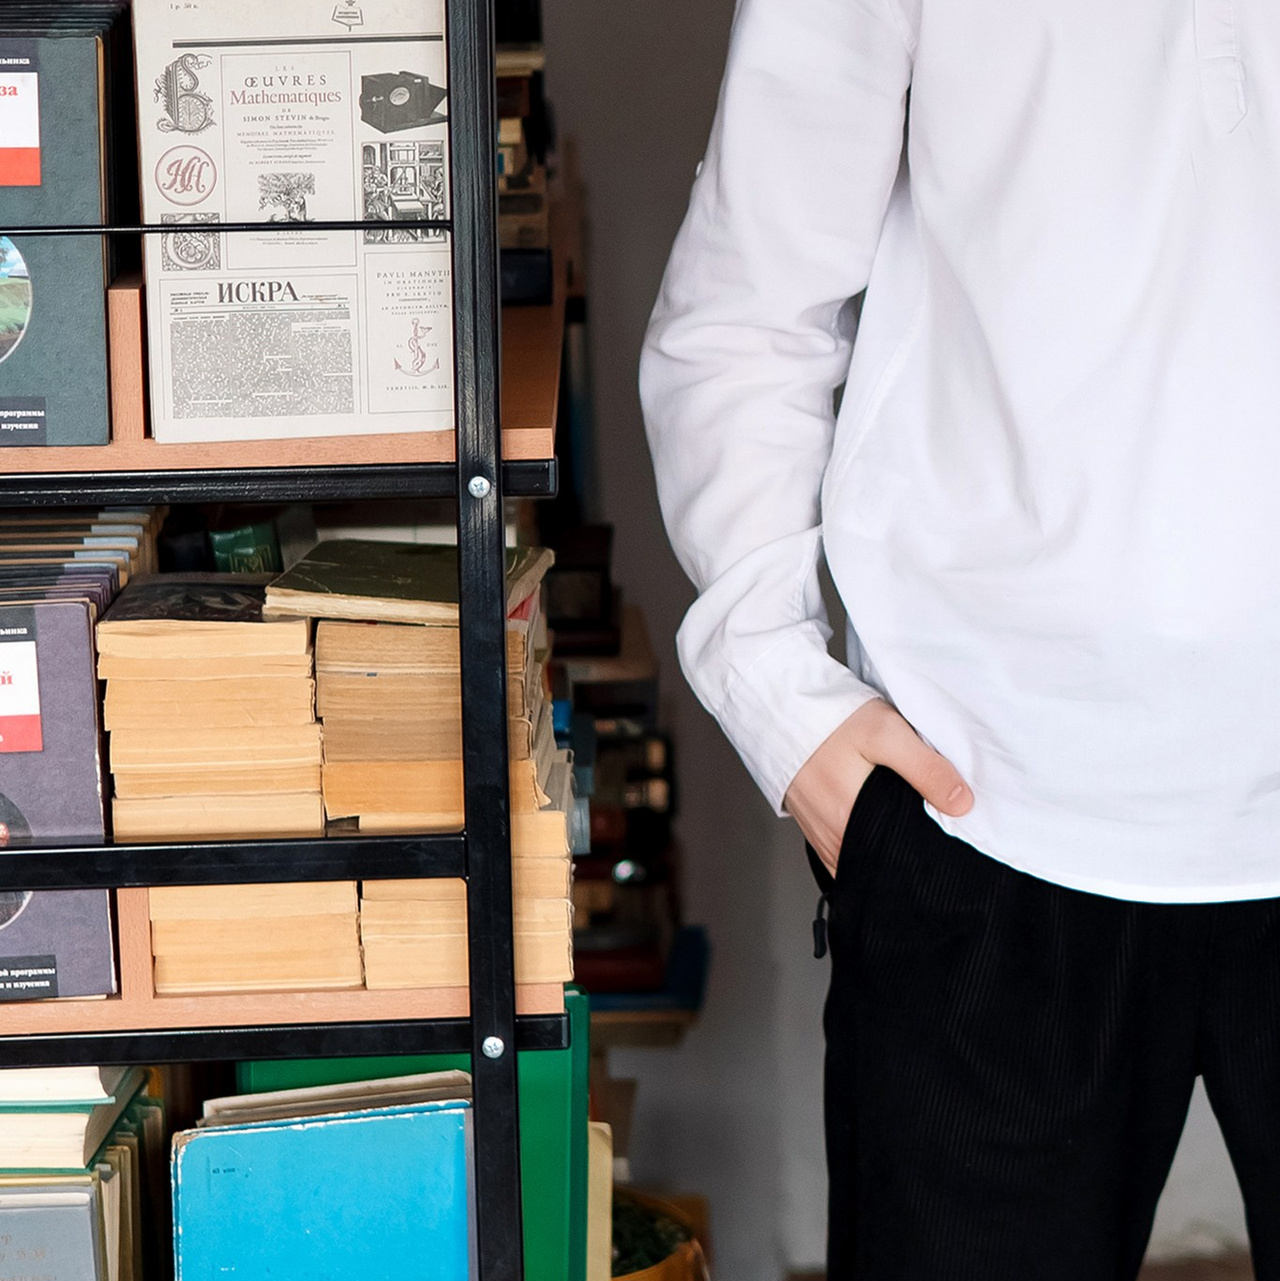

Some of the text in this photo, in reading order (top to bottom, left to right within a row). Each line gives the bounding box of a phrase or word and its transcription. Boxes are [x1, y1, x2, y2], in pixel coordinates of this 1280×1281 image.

[244, 74, 327, 87] ŒUVRES
[229, 89, 342, 107] Mathematiques
[217, 281, 300, 303] ИСКРА
[10, 968, 55, 978] программы
[13, 981, 50, 990] изучения
